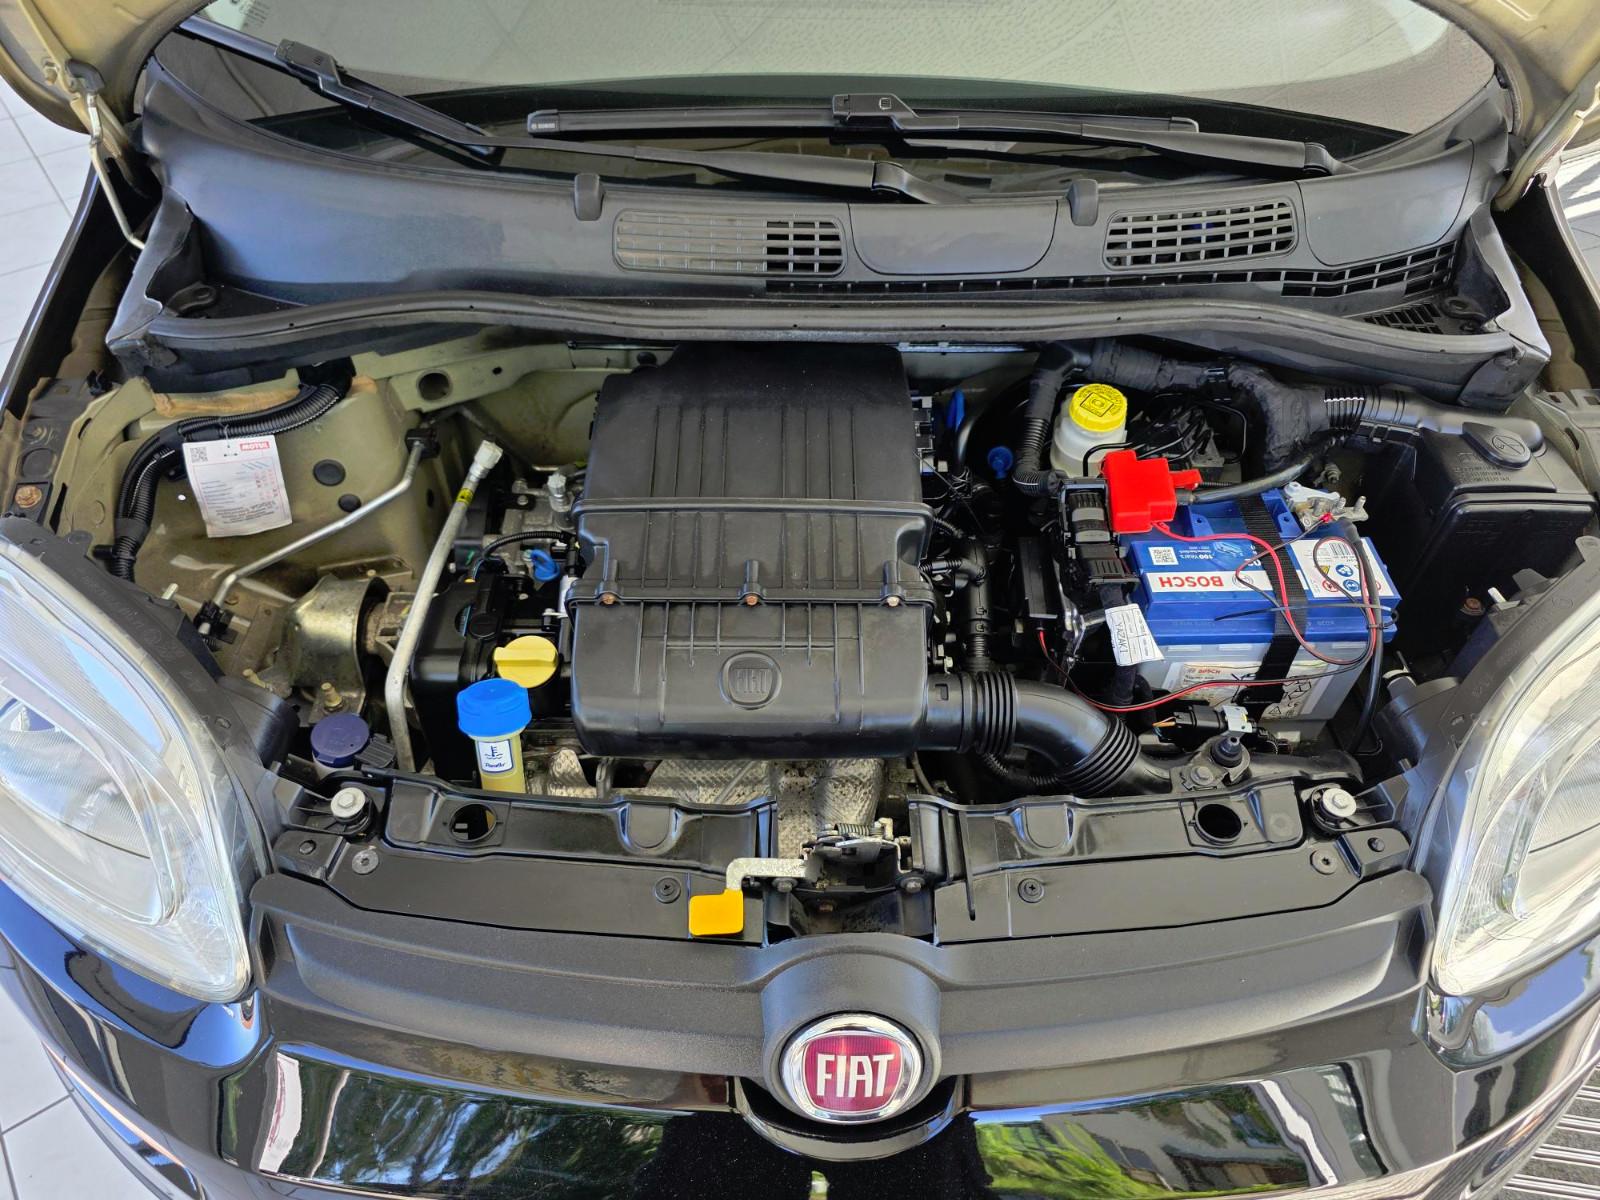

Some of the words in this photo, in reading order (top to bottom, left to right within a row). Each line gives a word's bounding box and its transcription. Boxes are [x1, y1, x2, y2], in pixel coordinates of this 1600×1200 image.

[241, 441, 269, 450] MOTUL
[1158, 575, 1224, 588] BOSCH
[1115, 622, 1129, 654] YAZAKI
[734, 667, 770, 694] FIAT
[816, 1053, 895, 1097] FIAT
